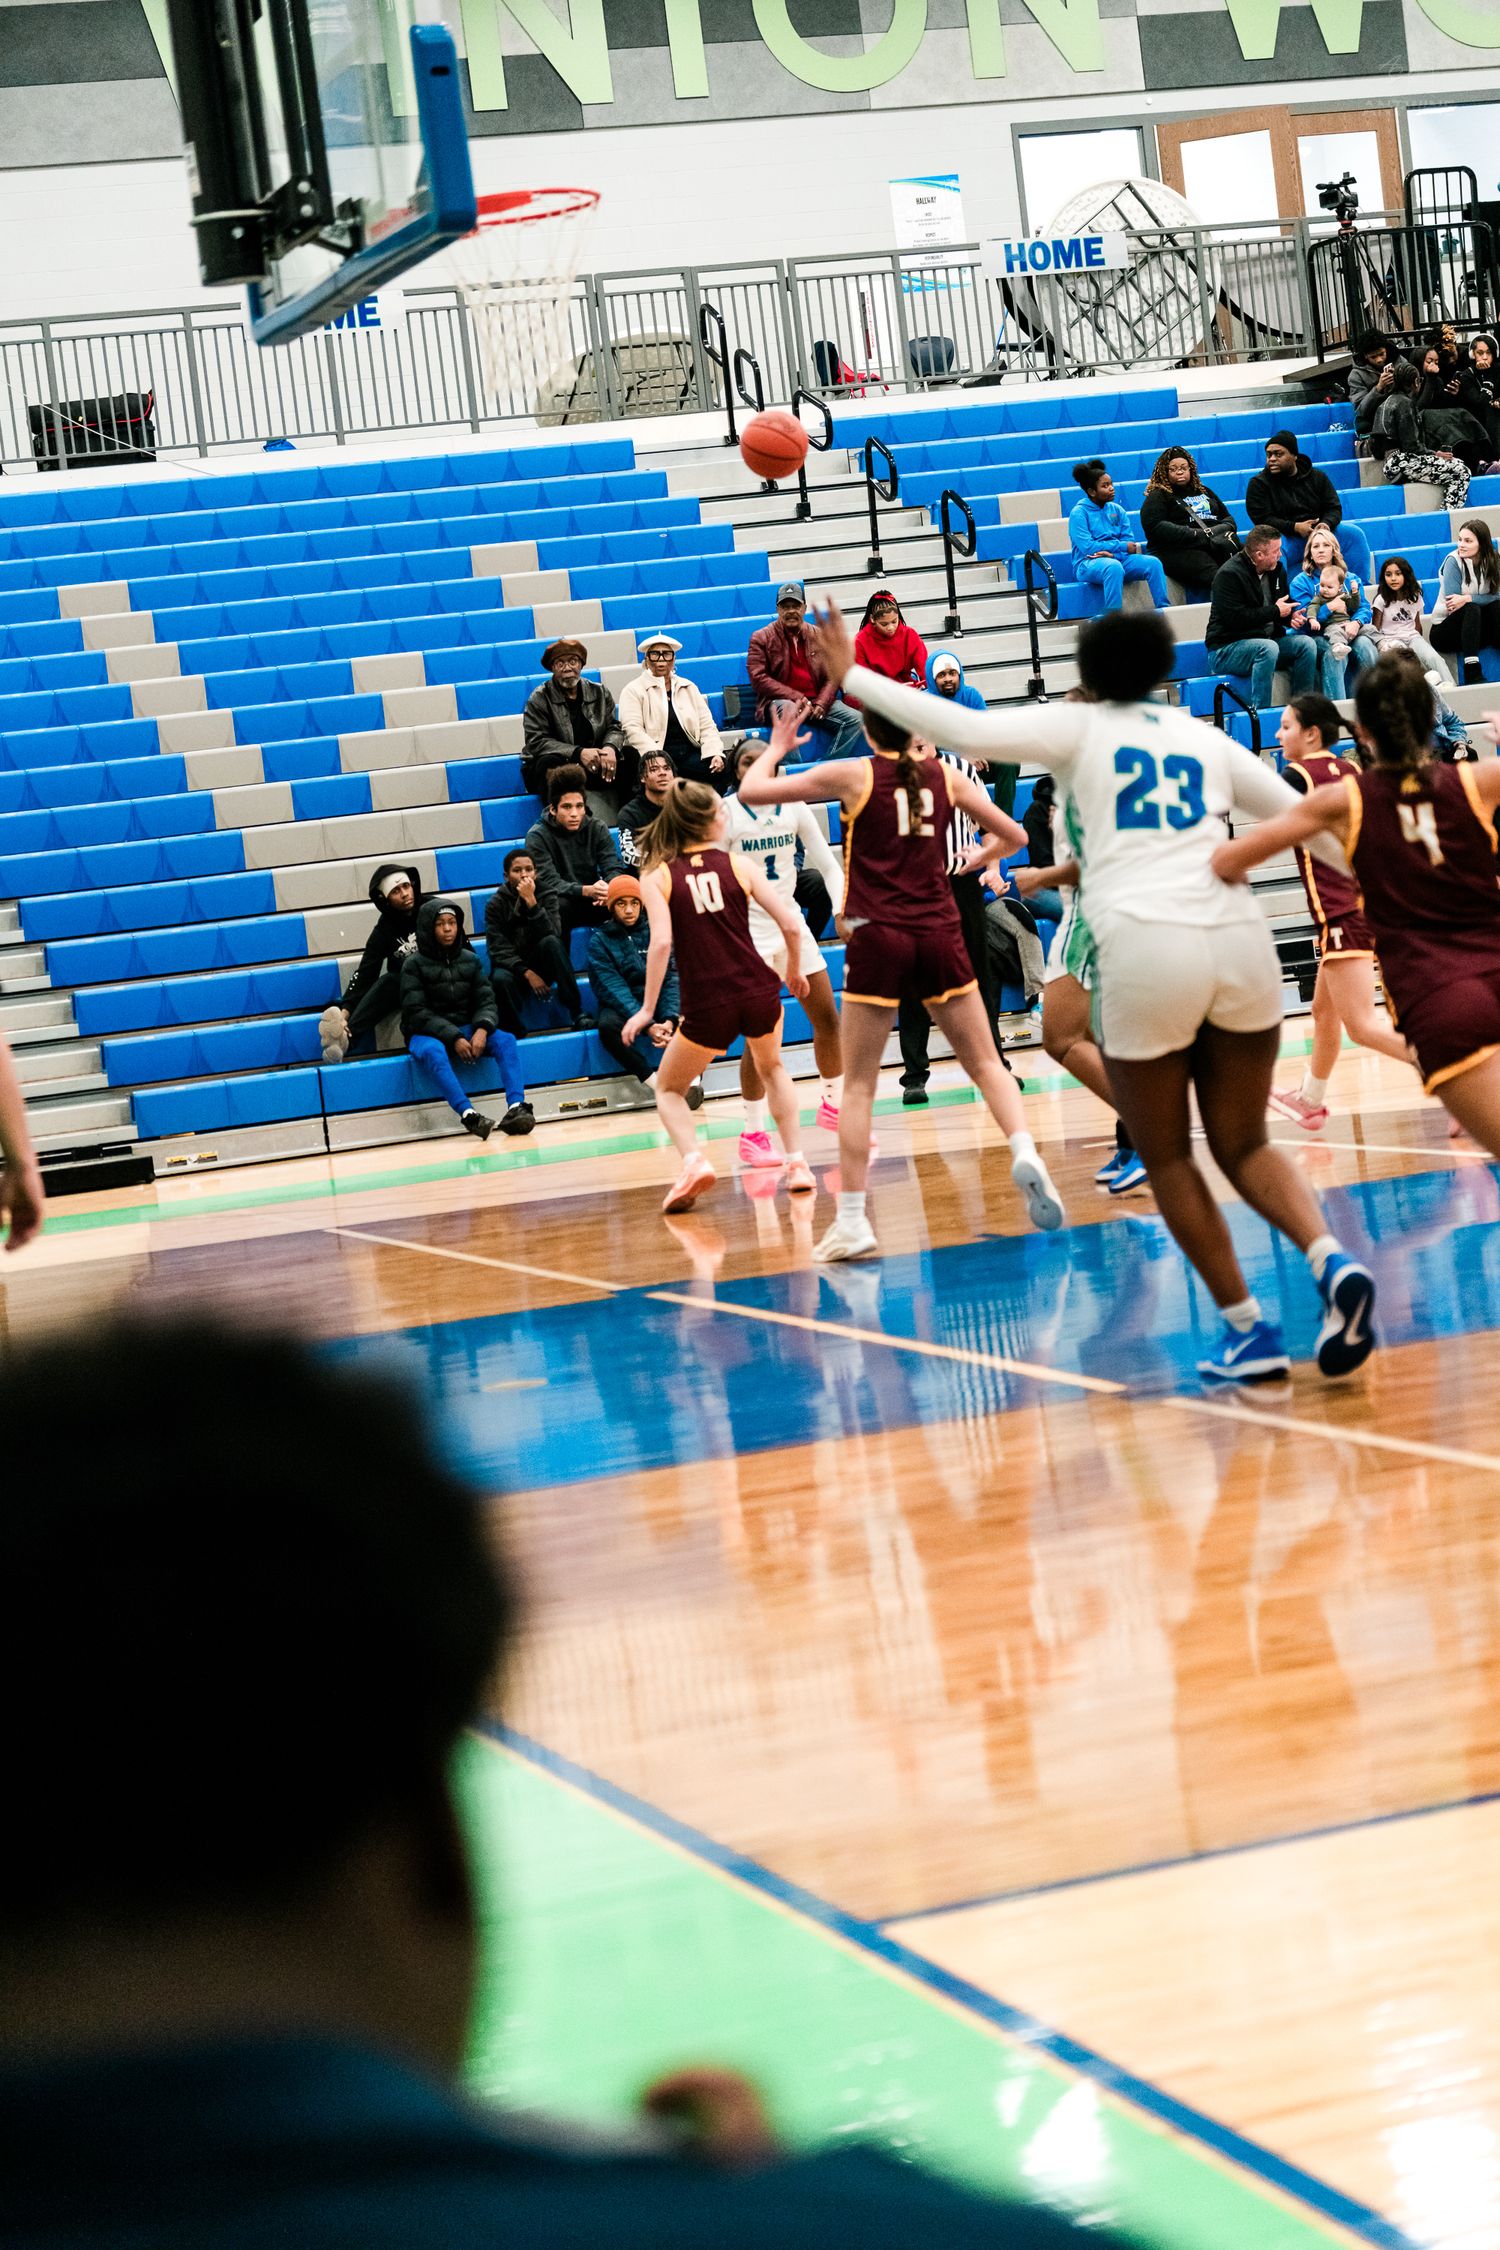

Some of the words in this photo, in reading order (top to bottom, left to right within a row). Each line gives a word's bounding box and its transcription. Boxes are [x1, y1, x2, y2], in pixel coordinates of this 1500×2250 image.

[1004, 236, 1105, 273] HOME
[1114, 746, 1207, 831] 23
[893, 787, 935, 837] 12
[741, 832, 794, 852] WARRIORS
[1396, 802, 1445, 866] 4
[764, 854, 780, 880] 1
[685, 871, 725, 914] 10
[1329, 927, 1344, 949] T
